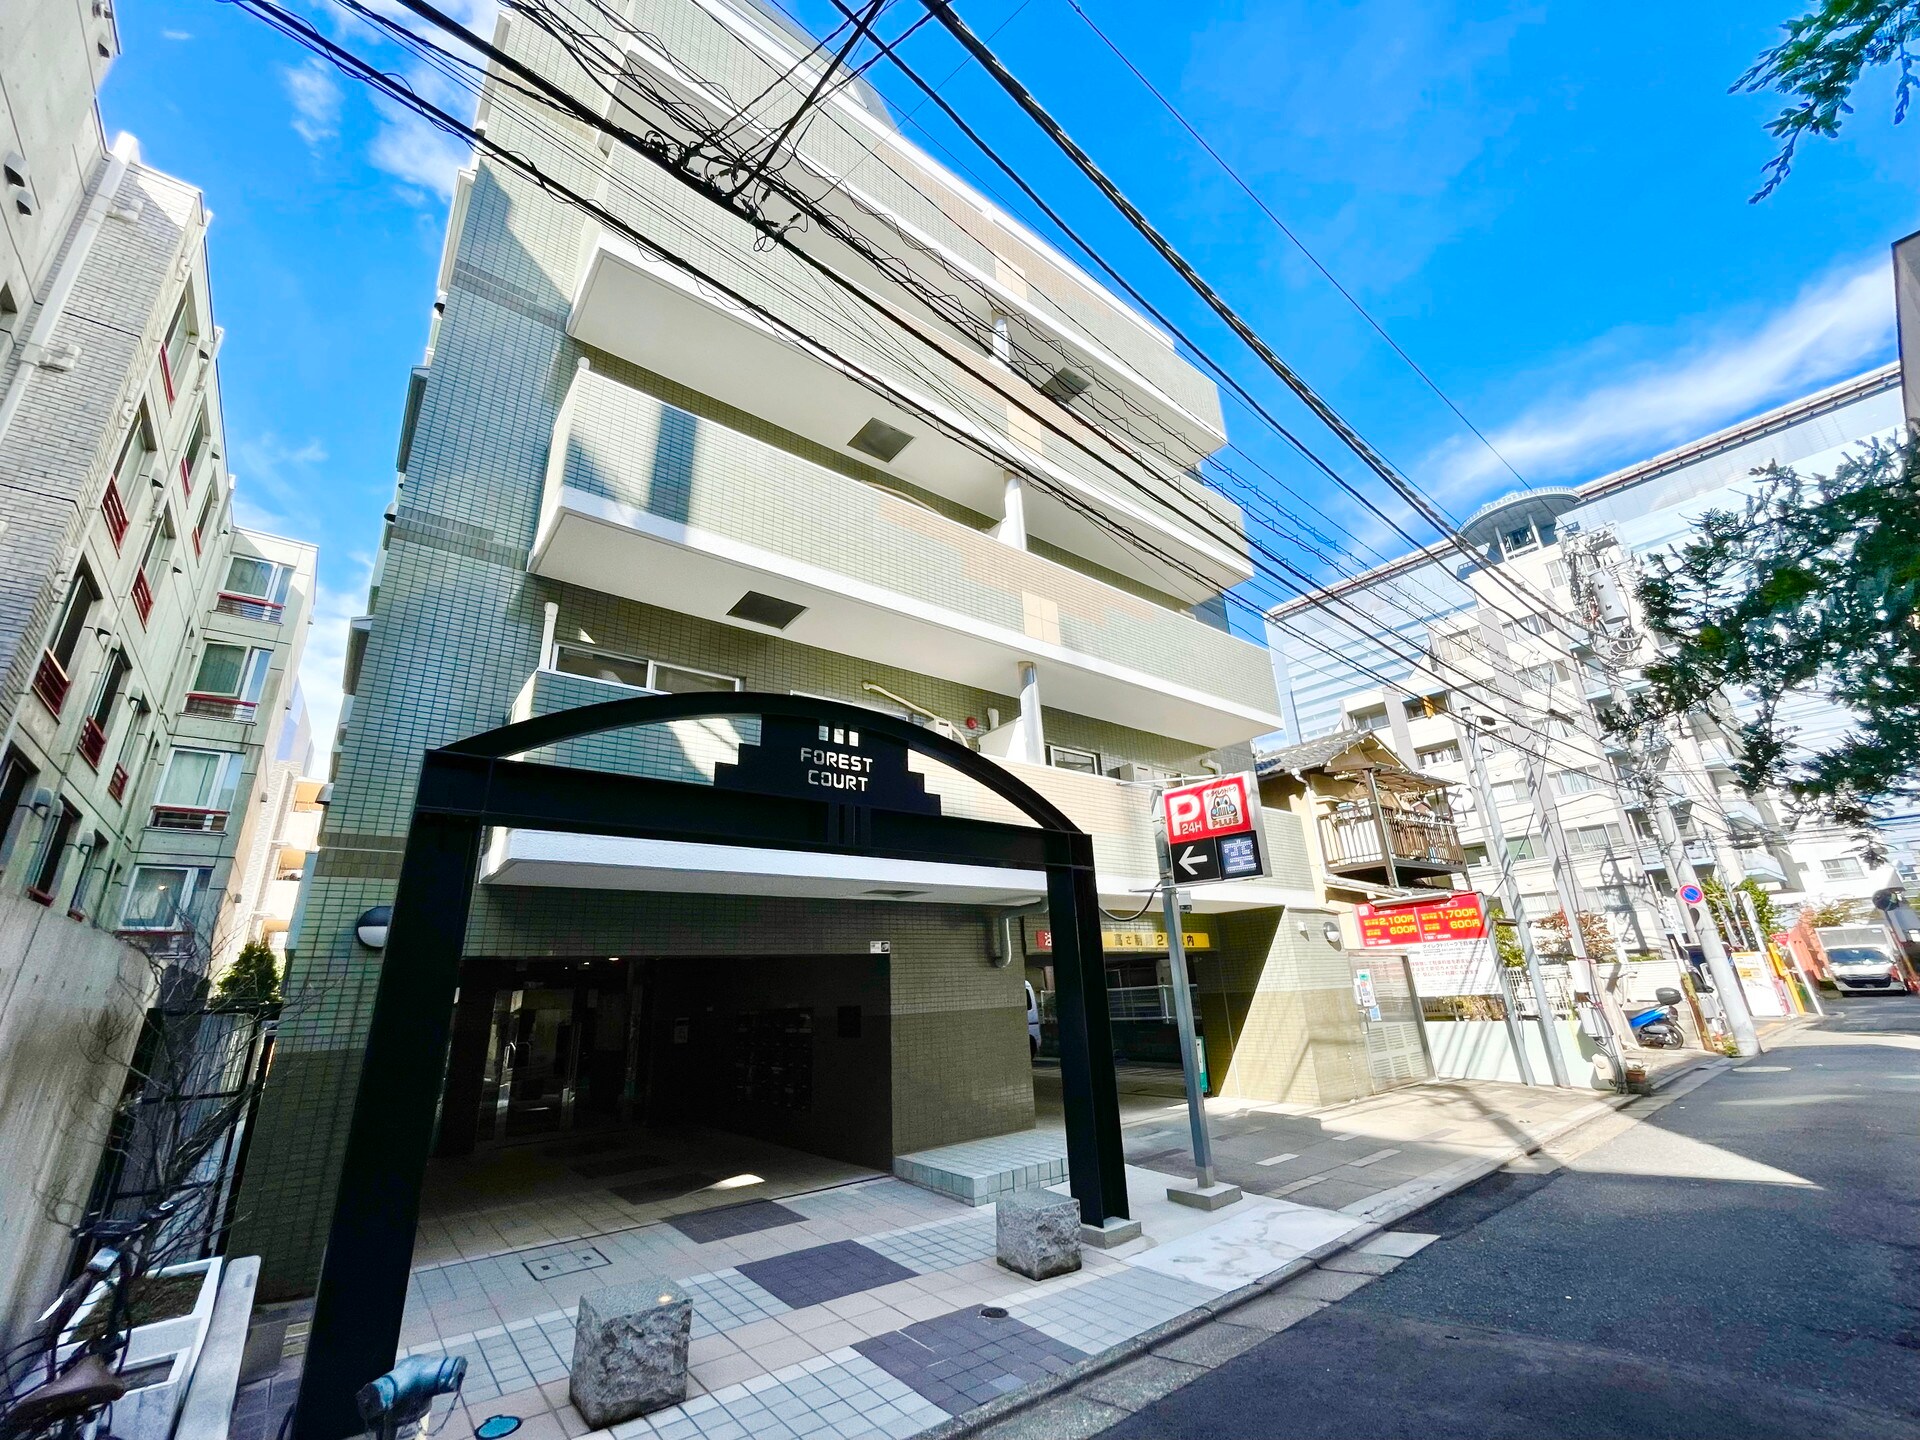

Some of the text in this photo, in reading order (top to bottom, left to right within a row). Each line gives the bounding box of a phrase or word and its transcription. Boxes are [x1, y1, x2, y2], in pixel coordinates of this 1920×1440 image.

[801, 747, 873, 773] FOREST
[808, 769, 868, 792] COURT
[1169, 794, 1201, 836] P
[1212, 816, 1239, 828] PLUS
[1181, 820, 1203, 835] 24H
[1390, 925, 1417, 935] 600円
[1450, 919, 1480, 929] 600円
